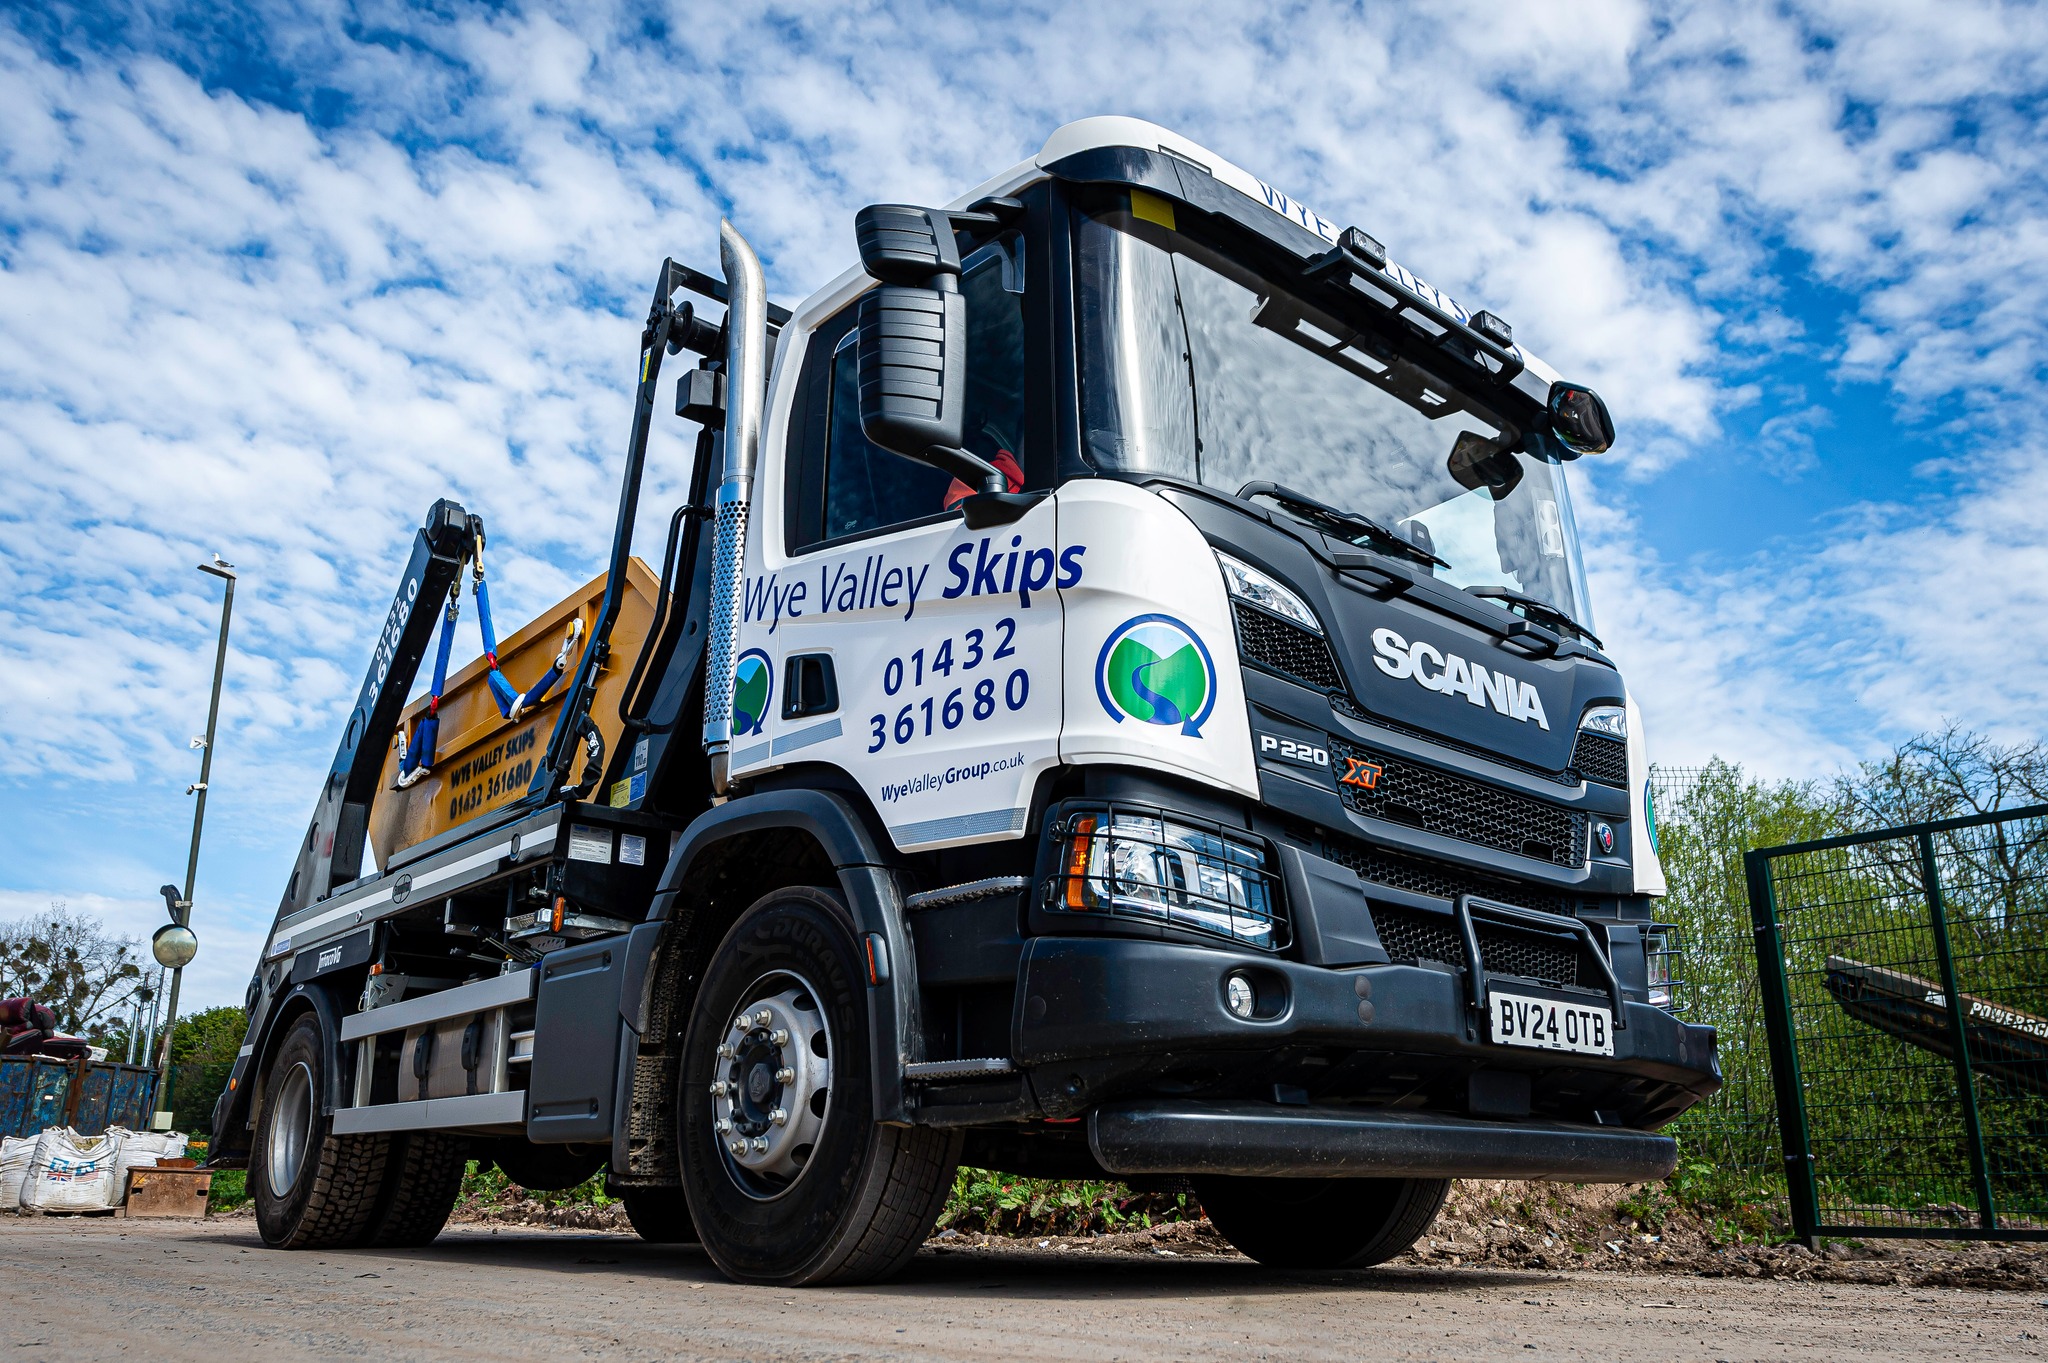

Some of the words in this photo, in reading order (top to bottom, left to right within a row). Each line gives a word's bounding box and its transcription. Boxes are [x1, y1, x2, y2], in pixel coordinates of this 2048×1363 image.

[1255, 177, 1333, 242] WYE
[744, 573, 807, 635] Wye
[821, 554, 930, 622] Valley
[942, 534, 1086, 609] Skips
[369, 577, 418, 708] 361680
[376, 596, 401, 661] 01432
[883, 617, 1016, 696] 01432
[868, 668, 1030, 754] 361680
[1372, 627, 1551, 731] SCANIA
[451, 762, 471, 790] WYE
[473, 743, 505, 778] VALLEY
[505, 726, 535, 760] SKIPS
[881, 751, 1025, 803] WyeValleyGroup.co.uk
[1260, 735, 1278, 752] P
[1280, 740, 1329, 767] 220
[1341, 757, 1382, 790] XT
[450, 783, 483, 820] 01432
[486, 758, 532, 801] 361680
[772, 916, 856, 1033] DURAVIS
[1499, 998, 1559, 1042] BV24
[1565, 1008, 1605, 1048] OTB
